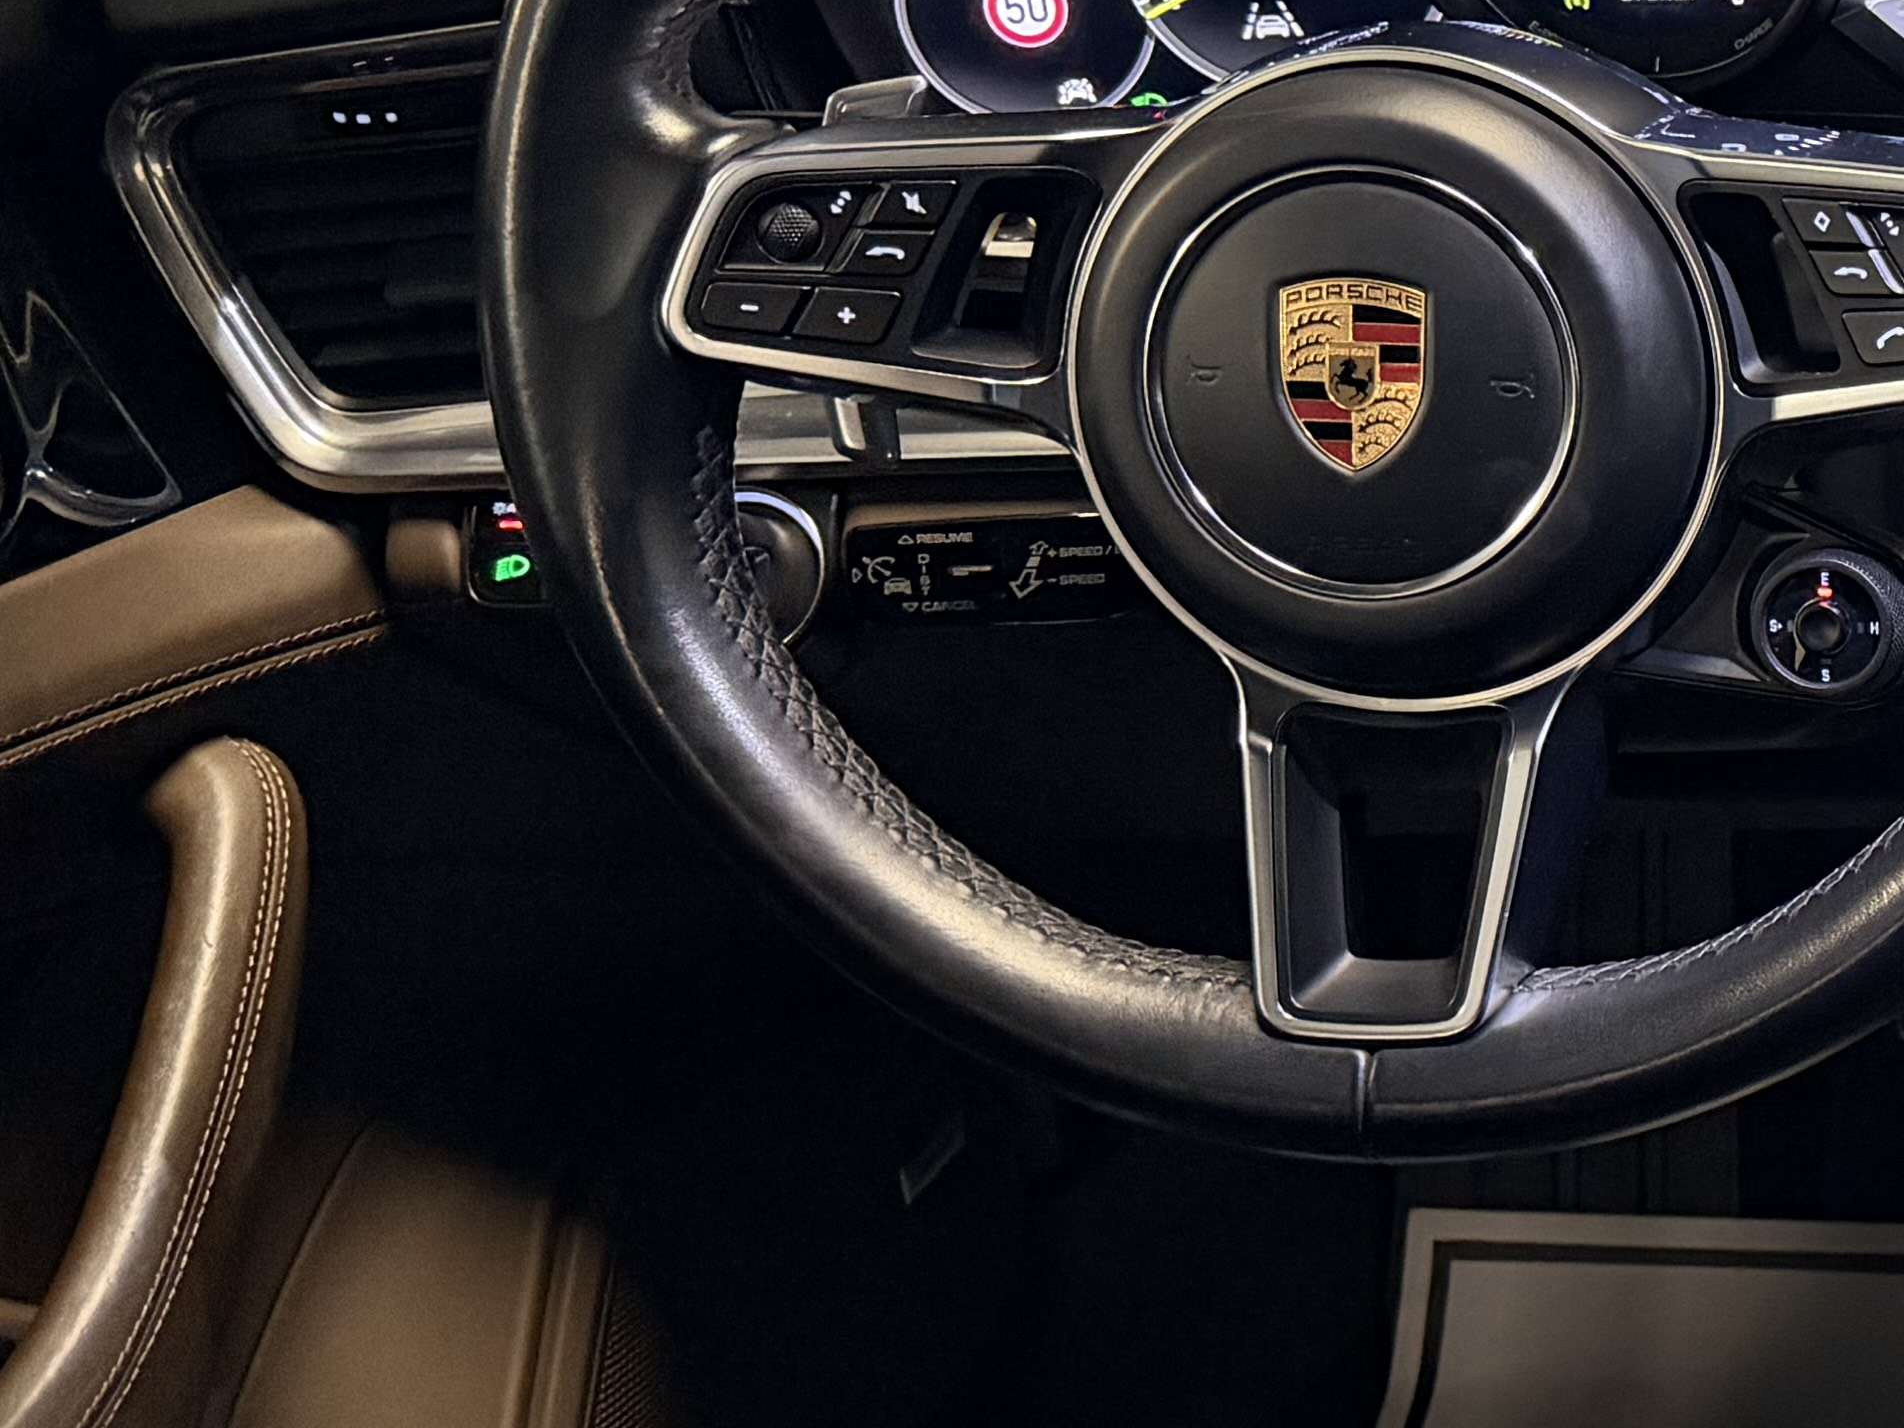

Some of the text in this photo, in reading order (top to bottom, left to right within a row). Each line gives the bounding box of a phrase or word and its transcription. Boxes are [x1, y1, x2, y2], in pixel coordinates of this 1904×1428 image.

[1285, 283, 1423, 312] PORSCHE
[1820, 572, 1830, 586] E
[1869, 621, 1880, 636] H
[1821, 668, 1831, 683] S
